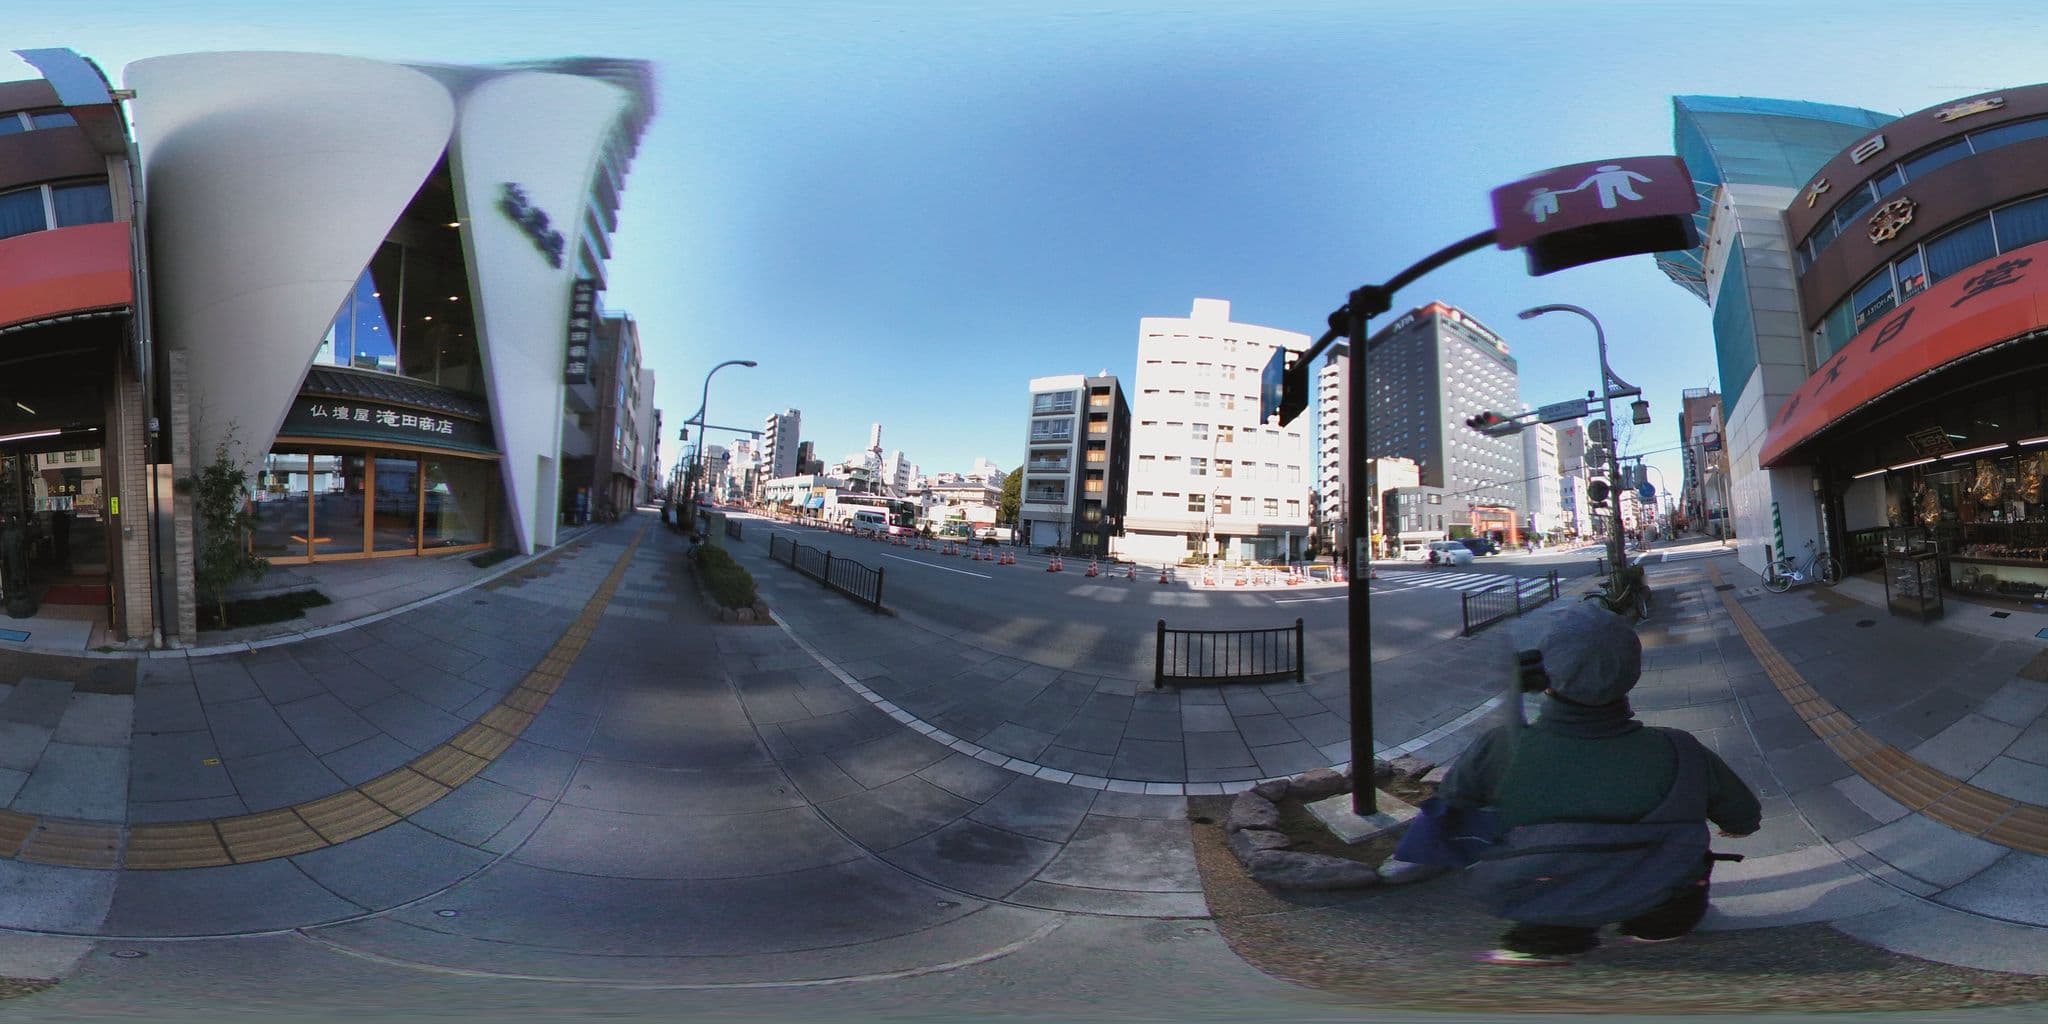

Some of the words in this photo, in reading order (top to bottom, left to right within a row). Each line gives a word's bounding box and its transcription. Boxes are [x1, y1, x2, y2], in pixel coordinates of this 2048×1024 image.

[1806, 97, 2004, 209] 大日堂
[310, 404, 370, 422] 仏壇屋
[376, 408, 454, 435] 滝田商店
